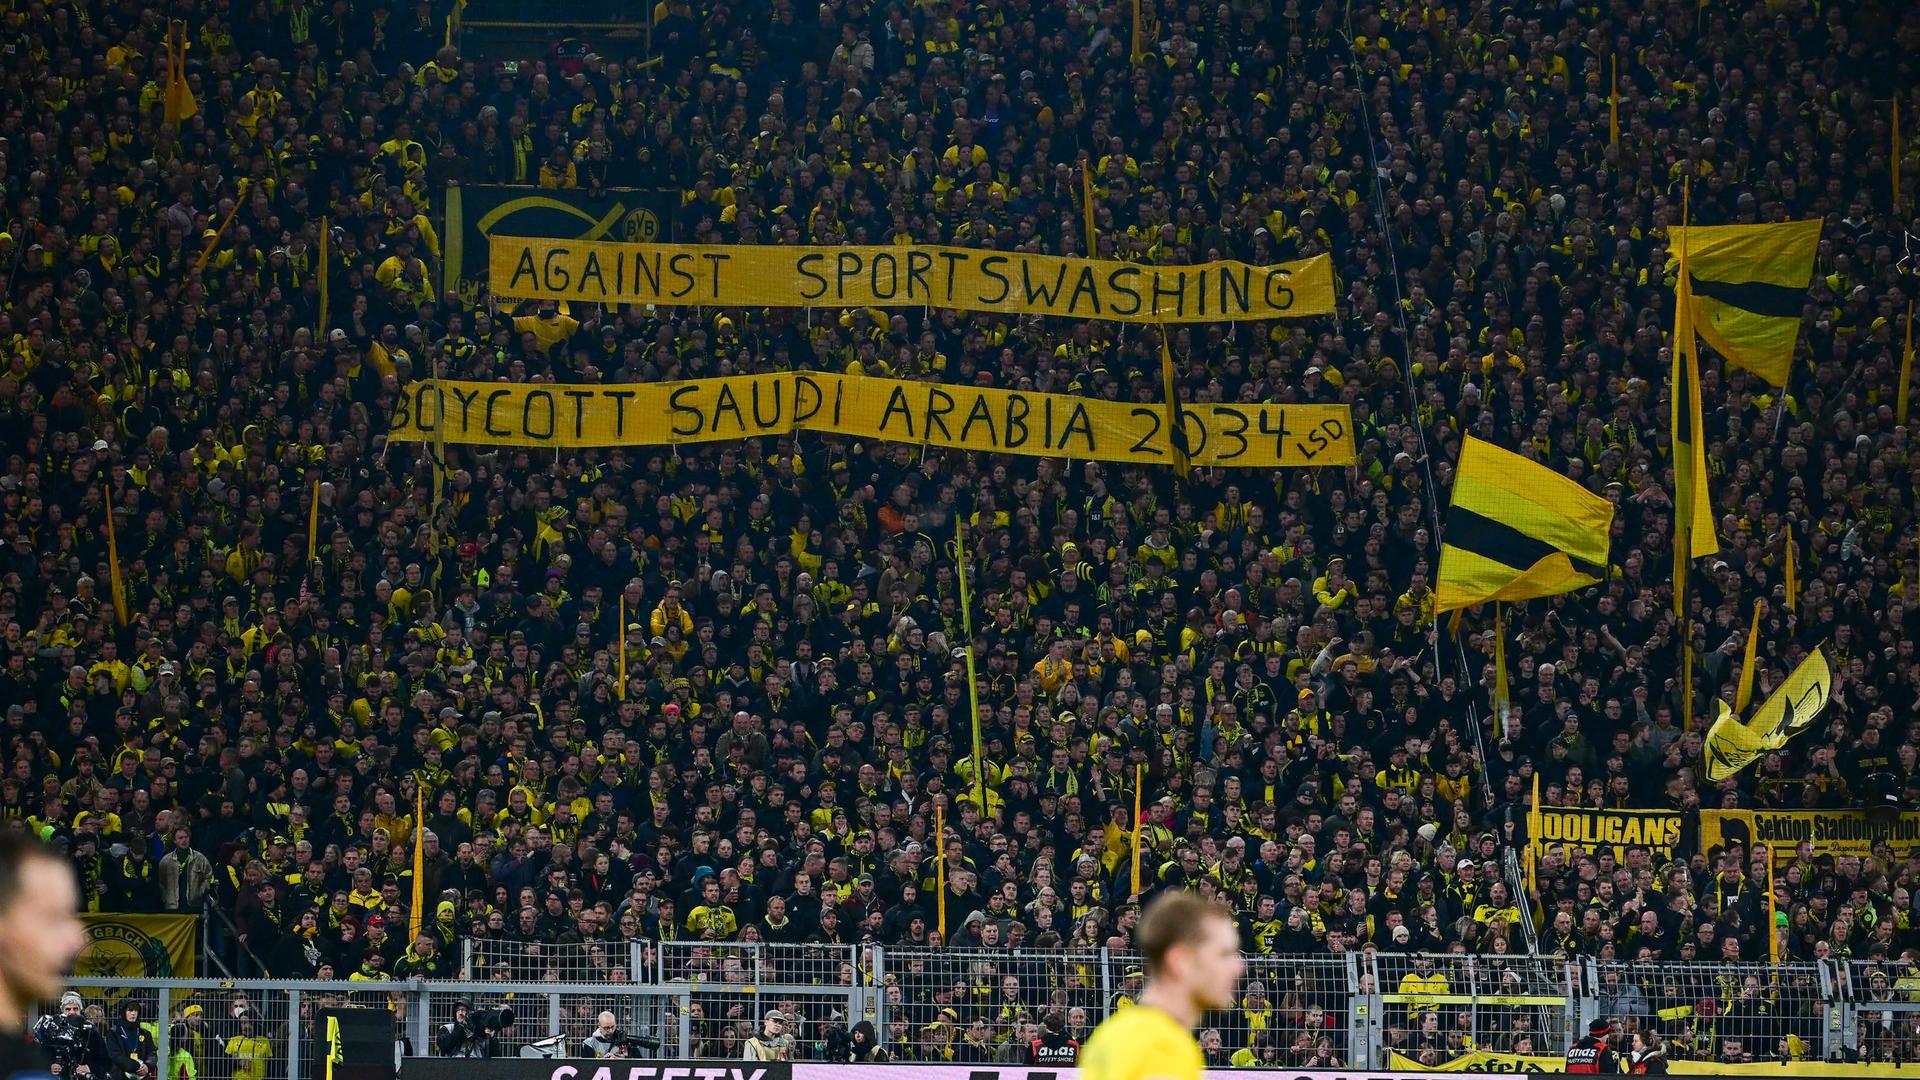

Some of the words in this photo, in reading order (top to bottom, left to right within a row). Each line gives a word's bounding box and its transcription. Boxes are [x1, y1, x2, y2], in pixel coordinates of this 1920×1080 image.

[626, 210, 655, 237] BVB
[510, 247, 731, 297] AGAINST
[797, 250, 1294, 317] SPORTSWASHING
[390, 384, 636, 439] BOYCOTT
[670, 376, 844, 436] SAUDI
[879, 386, 1096, 452] ARABIA
[1130, 407, 1291, 459] 2034
[1296, 419, 1342, 459] LSD
[1526, 811, 1682, 846] HOOLIGANS
[1754, 814, 1811, 841] Sektion
[87, 926, 145, 949] GBACH
